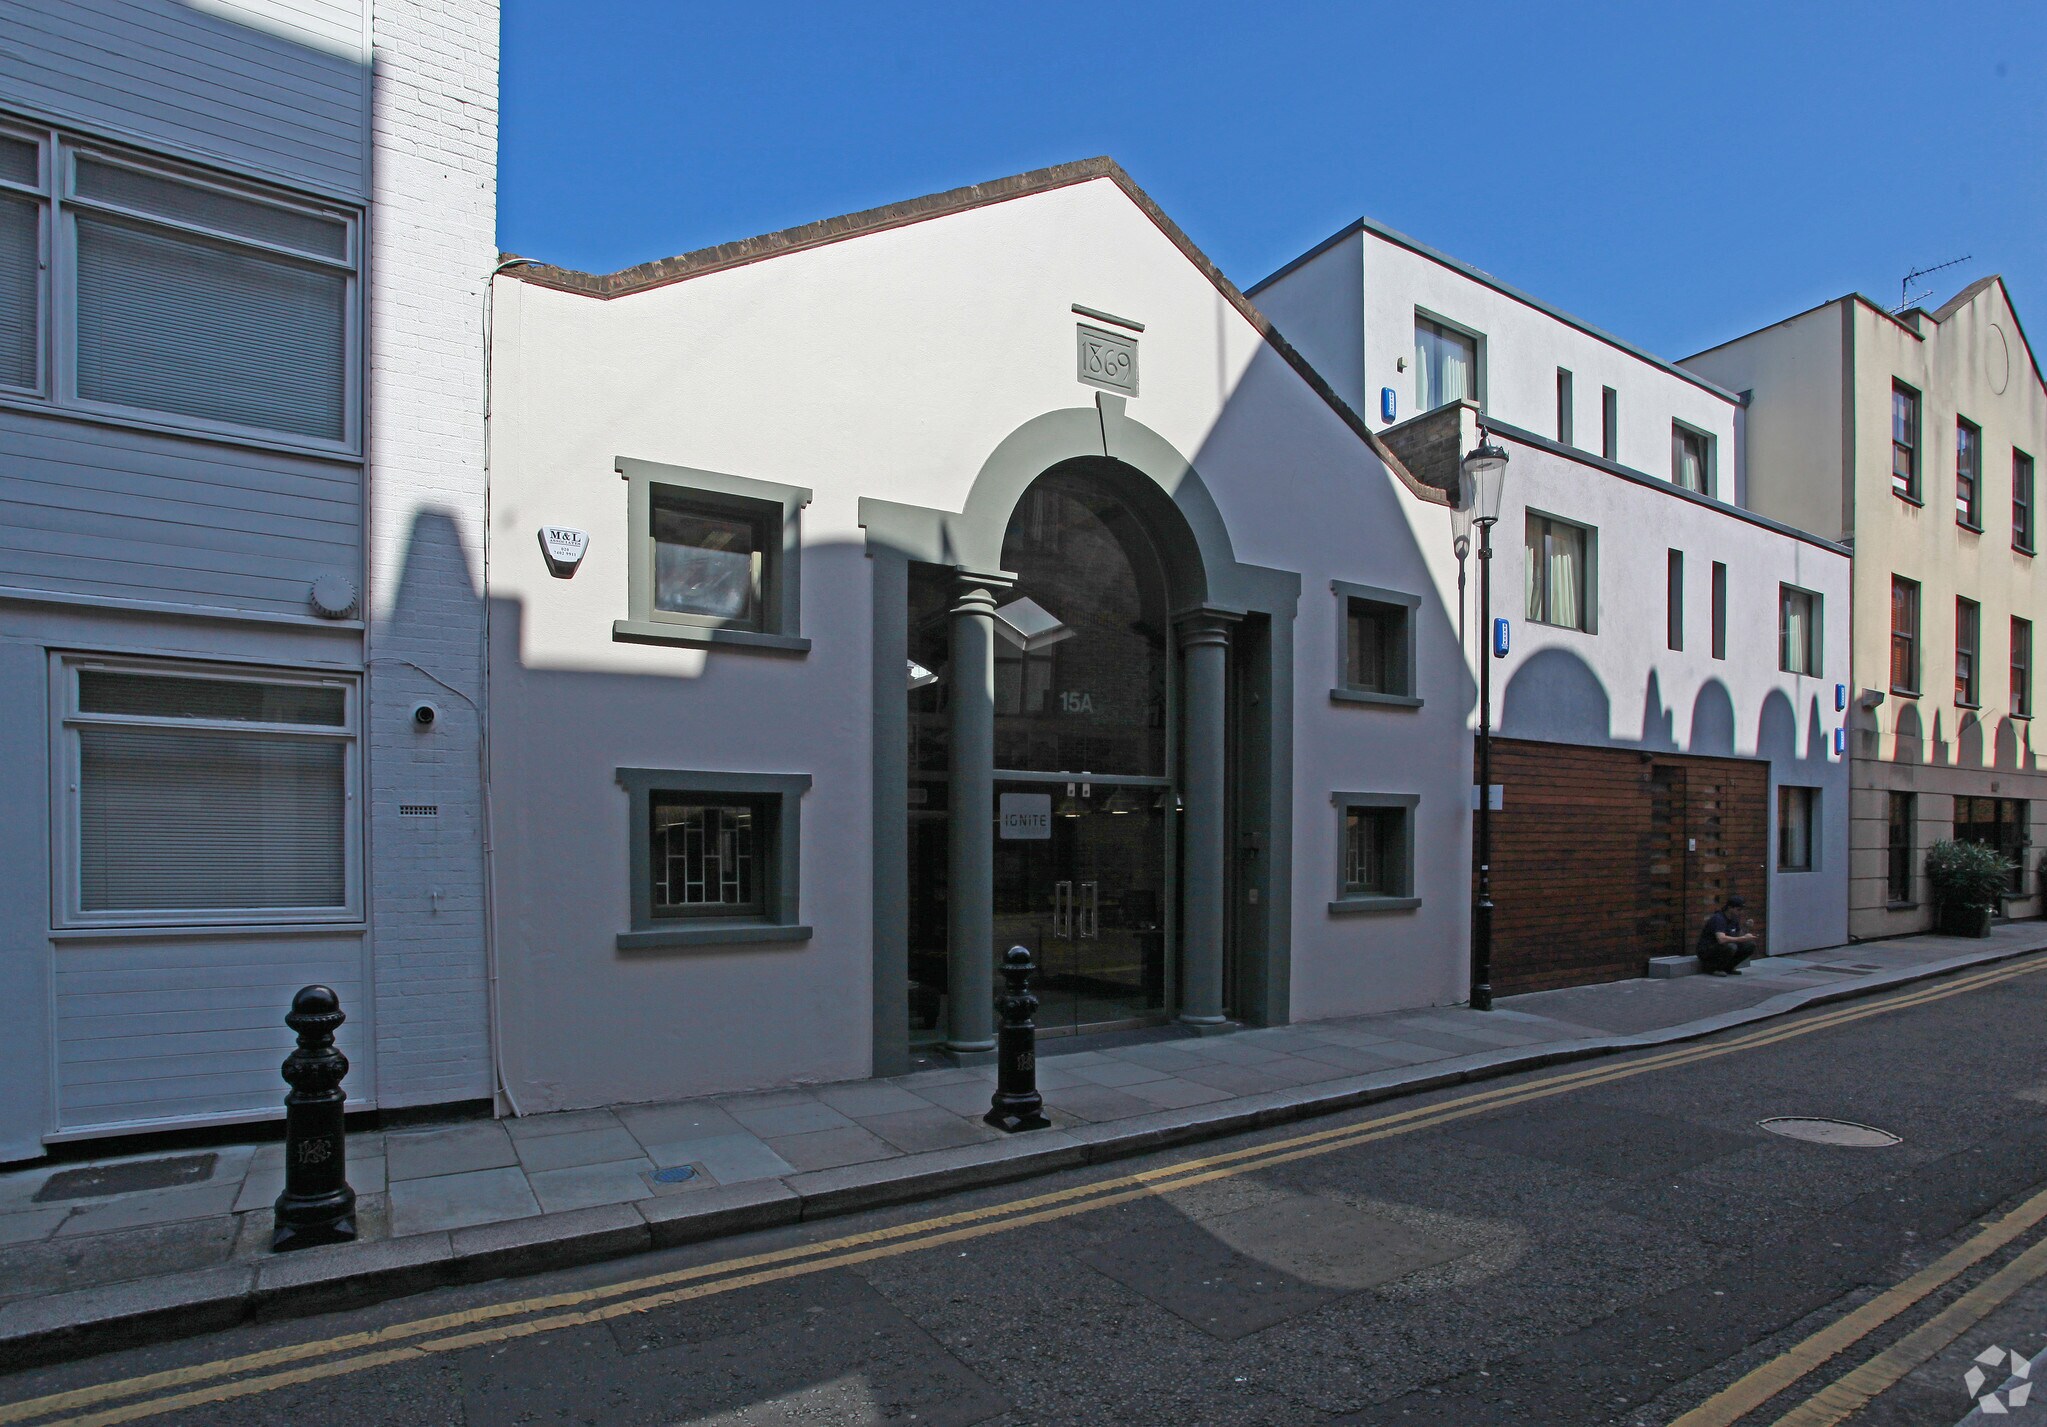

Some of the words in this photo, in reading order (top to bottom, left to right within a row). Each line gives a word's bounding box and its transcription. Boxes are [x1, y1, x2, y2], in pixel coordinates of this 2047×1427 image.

[1081, 341, 1131, 382] 1869
[1059, 691, 1094, 714] 15A
[1005, 814, 1047, 827] IGNITE
